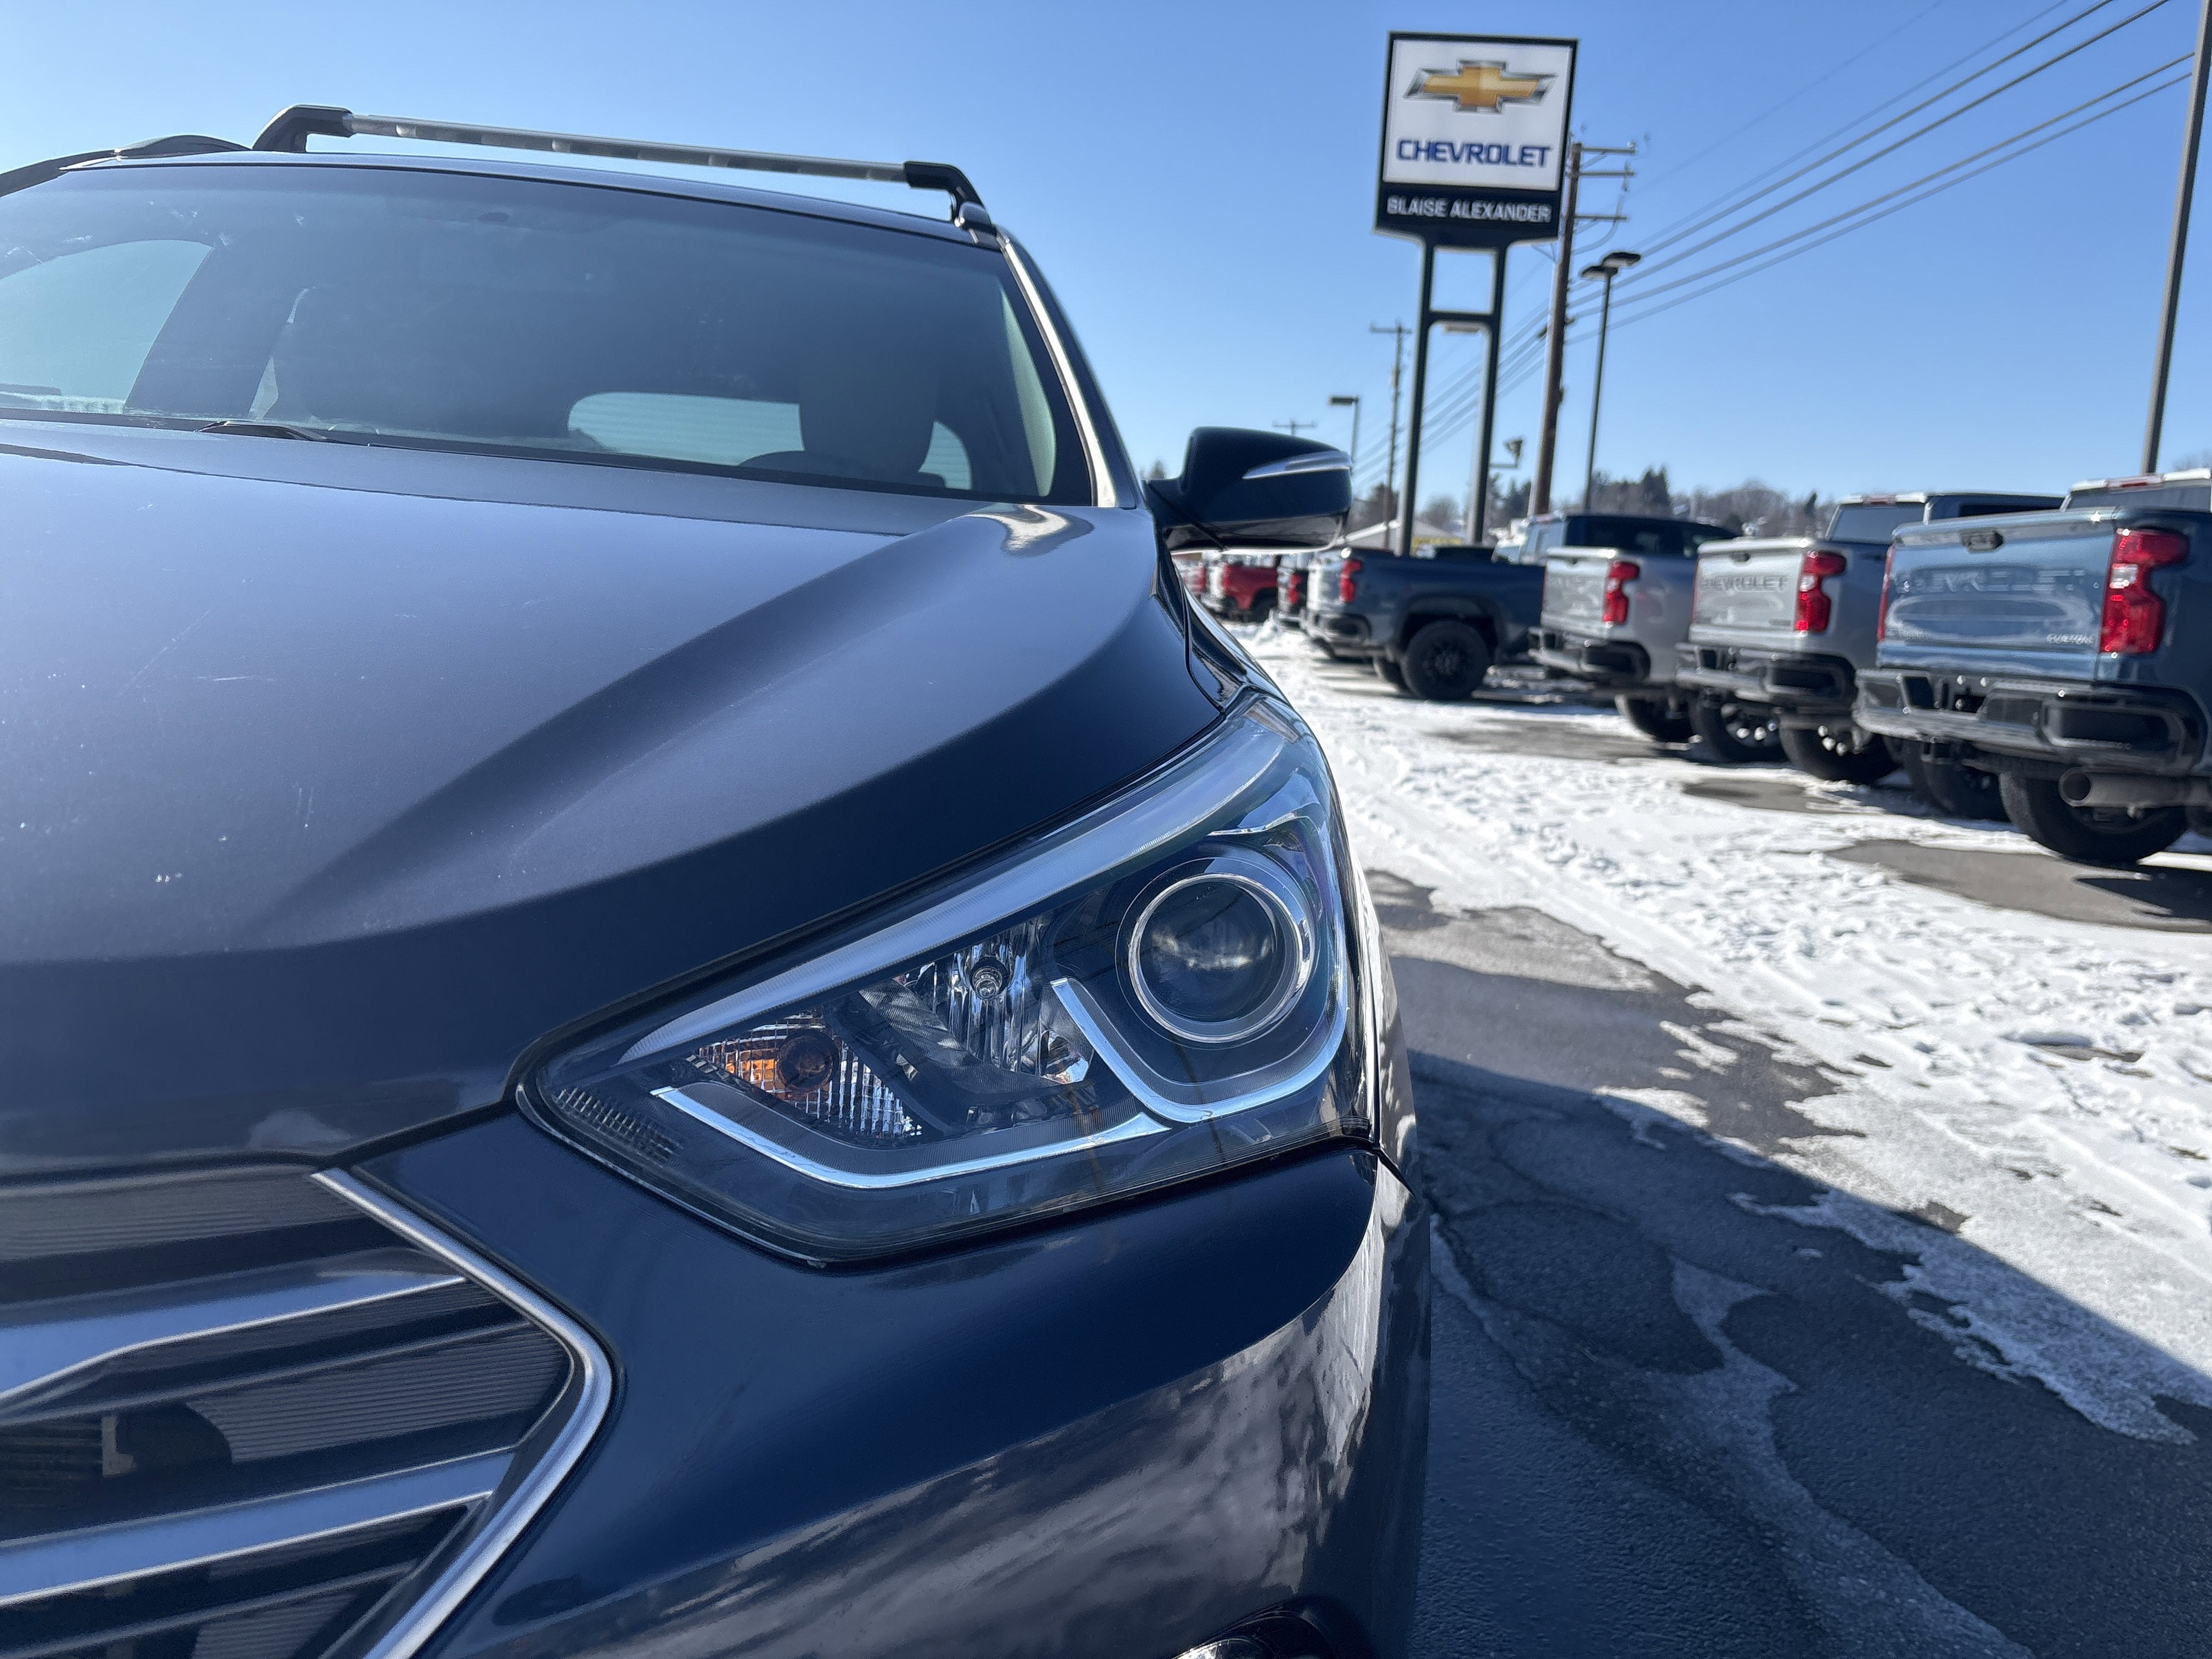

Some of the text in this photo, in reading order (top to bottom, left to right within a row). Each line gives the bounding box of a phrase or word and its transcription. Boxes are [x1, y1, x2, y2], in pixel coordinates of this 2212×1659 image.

[1396, 139, 1552, 167] CHEVROLET
[1387, 195, 1553, 223] BLAISE ALEXANDER
